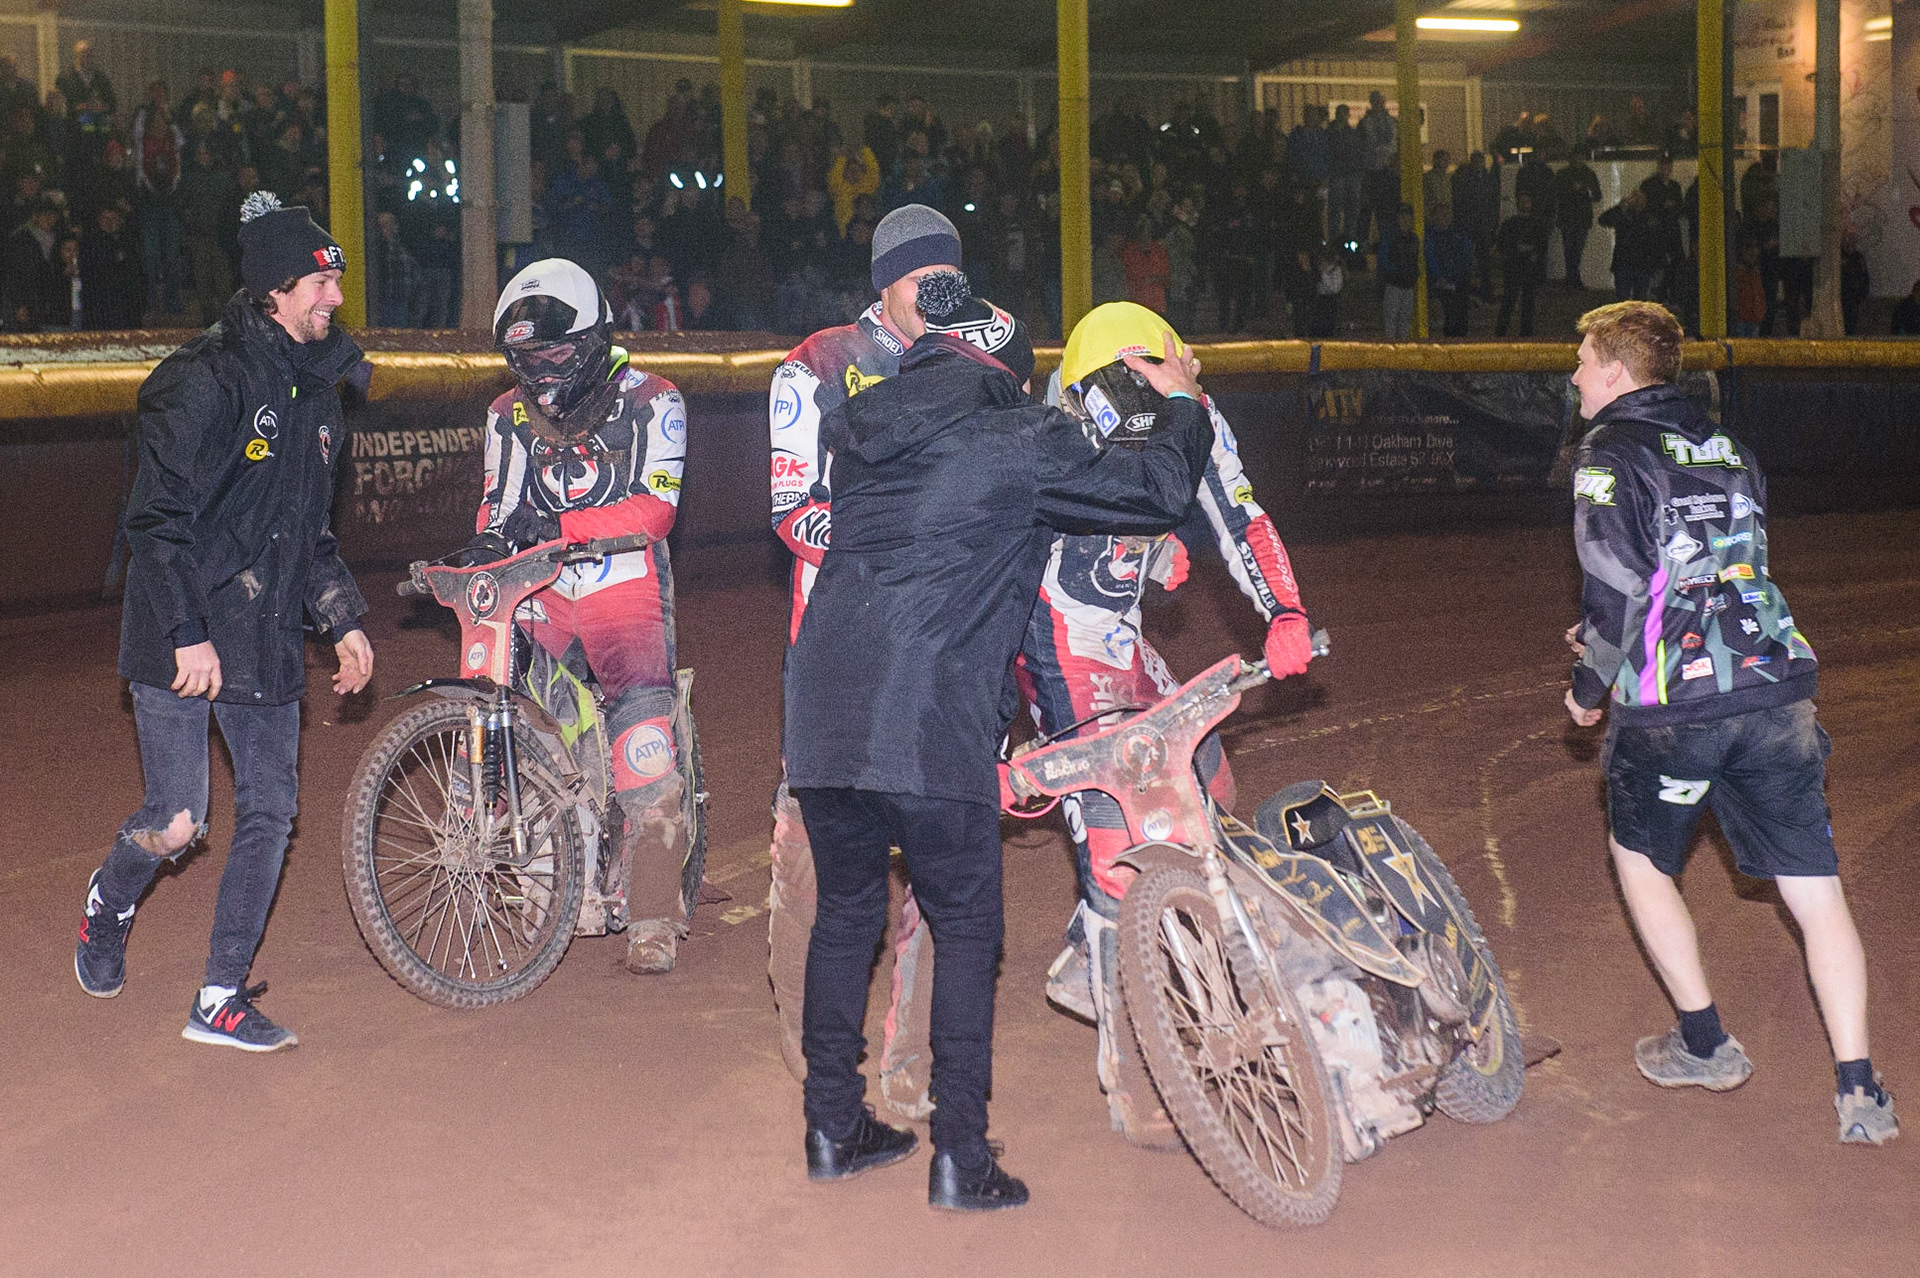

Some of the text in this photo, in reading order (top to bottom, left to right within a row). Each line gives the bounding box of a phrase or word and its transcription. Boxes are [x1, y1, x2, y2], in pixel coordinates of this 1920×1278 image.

[328, 246, 346, 263] FT
[875, 329, 901, 354] SHOEI
[961, 324, 1006, 348] FTS
[1372, 435, 1420, 450] Oakham
[634, 738, 665, 763] ATPI
